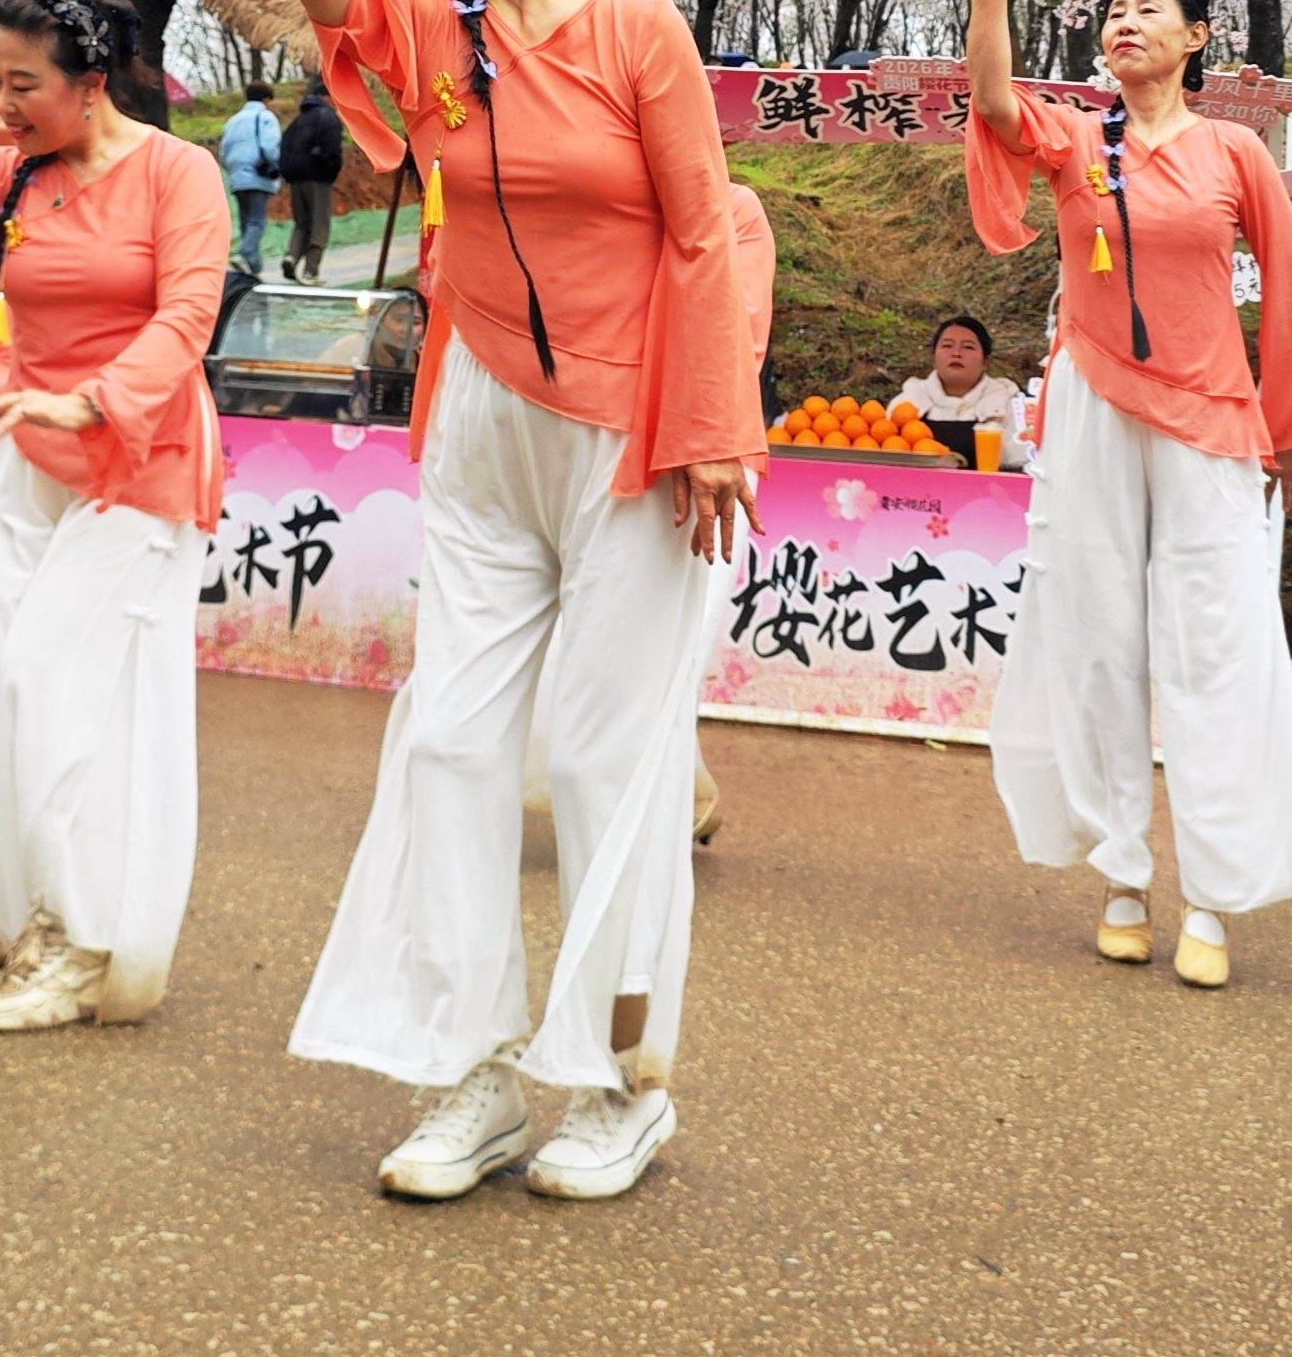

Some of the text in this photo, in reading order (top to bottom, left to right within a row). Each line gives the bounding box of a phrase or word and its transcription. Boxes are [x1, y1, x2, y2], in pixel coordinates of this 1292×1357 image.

[884, 61, 953, 76] 2026年
[883, 74, 969, 92] 贵阳樱花节
[1197, 98, 1278, 123] 不如你
